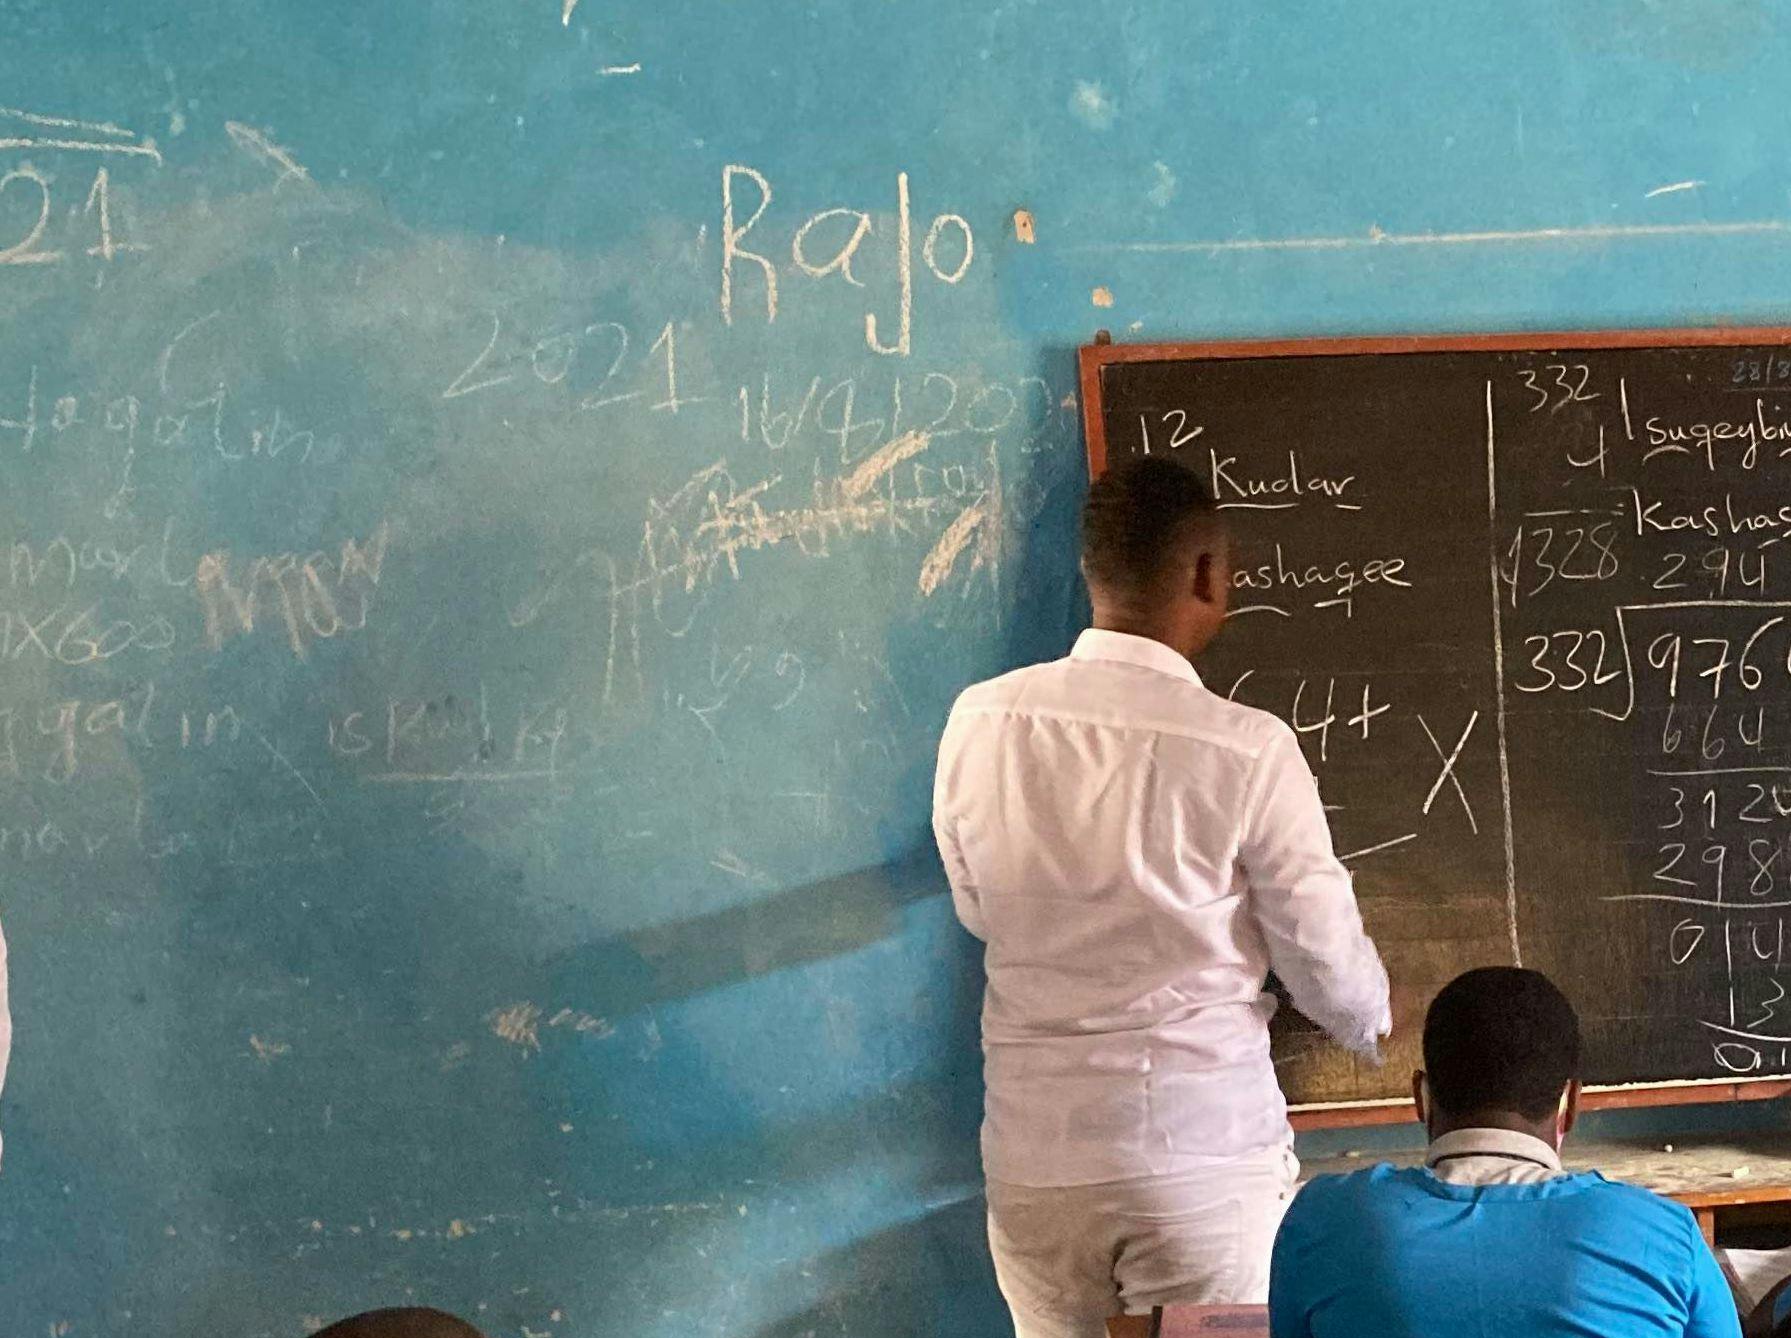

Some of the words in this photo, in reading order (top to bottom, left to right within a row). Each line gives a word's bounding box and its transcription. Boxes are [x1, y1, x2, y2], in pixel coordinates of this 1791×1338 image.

[442, 308, 708, 413] 2021
[1516, 363, 1602, 413] 332
[1139, 409, 1204, 455] 12
[1648, 548, 1766, 600] 294
[1514, 630, 1622, 693] 332
[1662, 706, 1764, 760] 664
